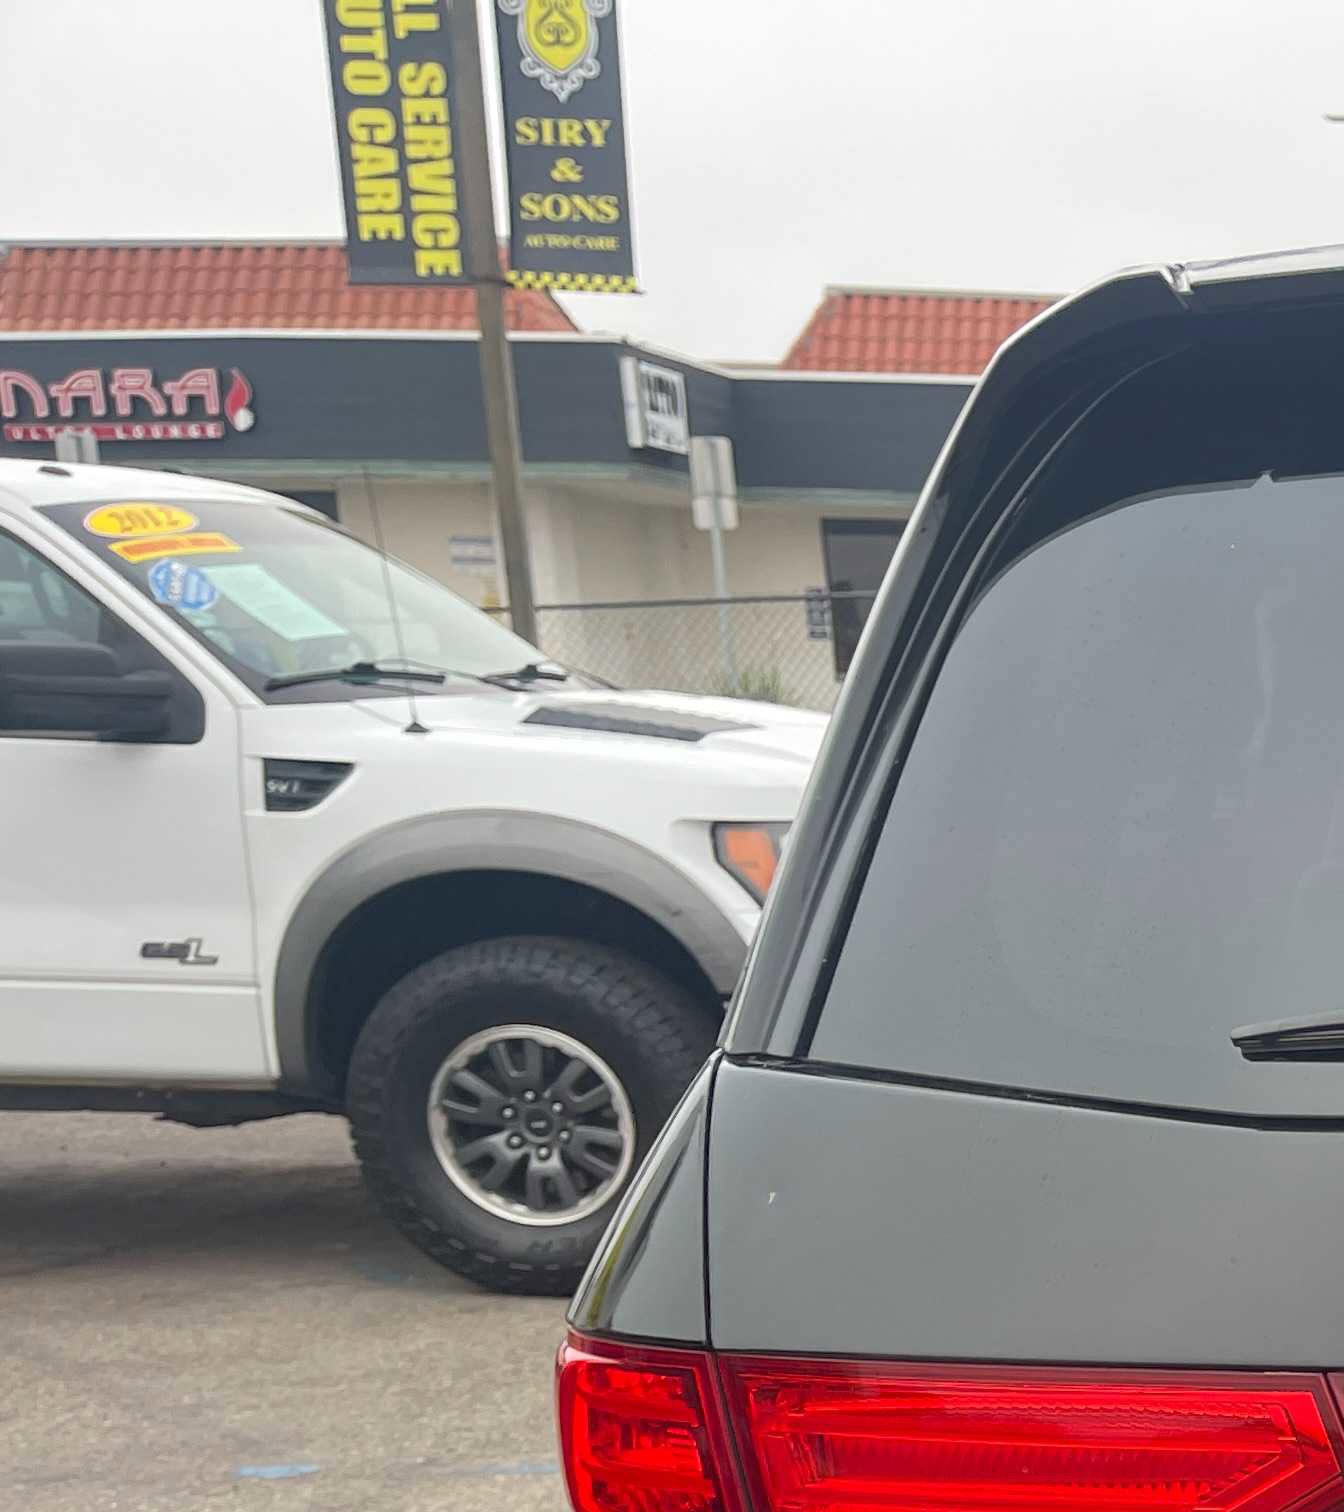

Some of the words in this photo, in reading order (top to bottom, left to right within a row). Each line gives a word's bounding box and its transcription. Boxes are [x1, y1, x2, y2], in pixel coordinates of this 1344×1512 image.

[514, 116, 612, 147] SIRY
[347, 107, 405, 242] CARE
[397, 61, 463, 278] SERVICE
[550, 156, 584, 183] &
[519, 191, 620, 224] SONS
[572, 234, 621, 251] CARE
[11, 427, 95, 440] ULT
